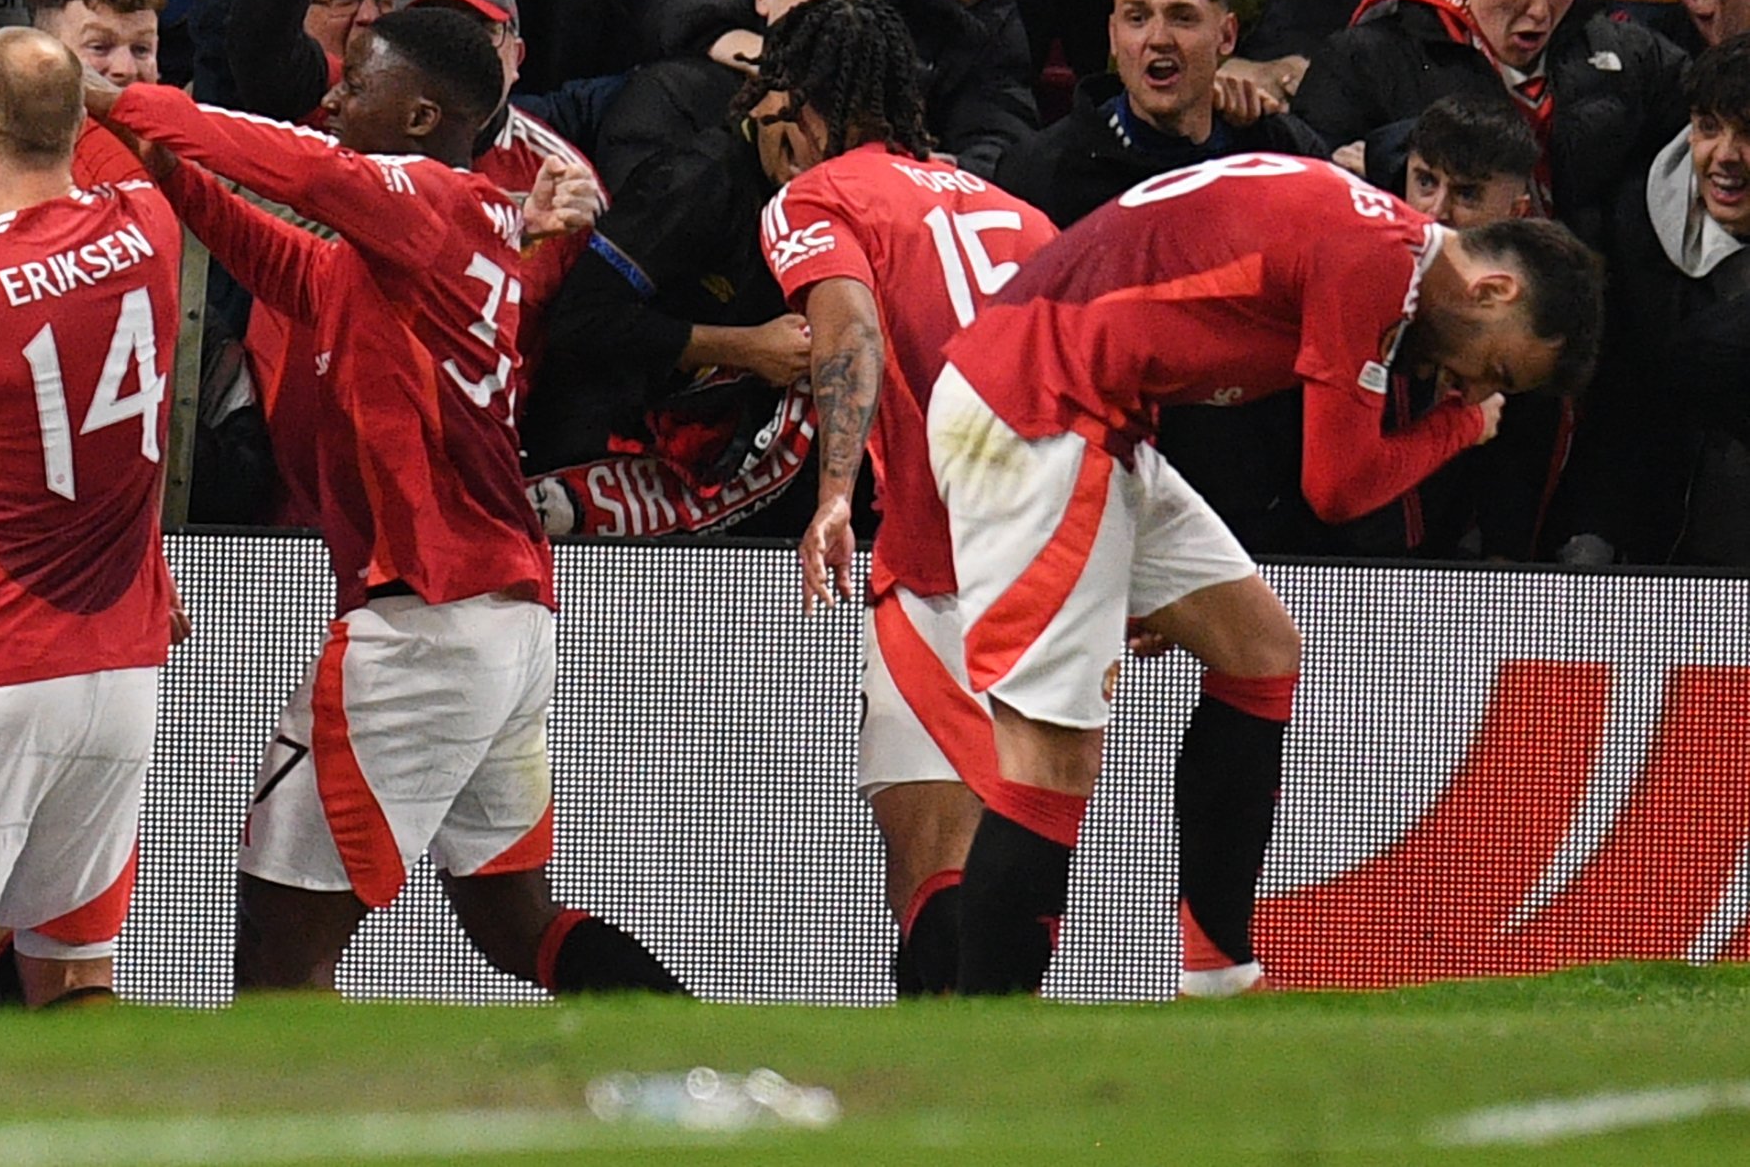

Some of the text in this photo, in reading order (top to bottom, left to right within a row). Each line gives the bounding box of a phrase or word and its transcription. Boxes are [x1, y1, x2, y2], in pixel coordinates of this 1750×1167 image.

[892, 162, 987, 195] YORO
[22, 286, 167, 501] 14
[587, 458, 677, 537] SIR
